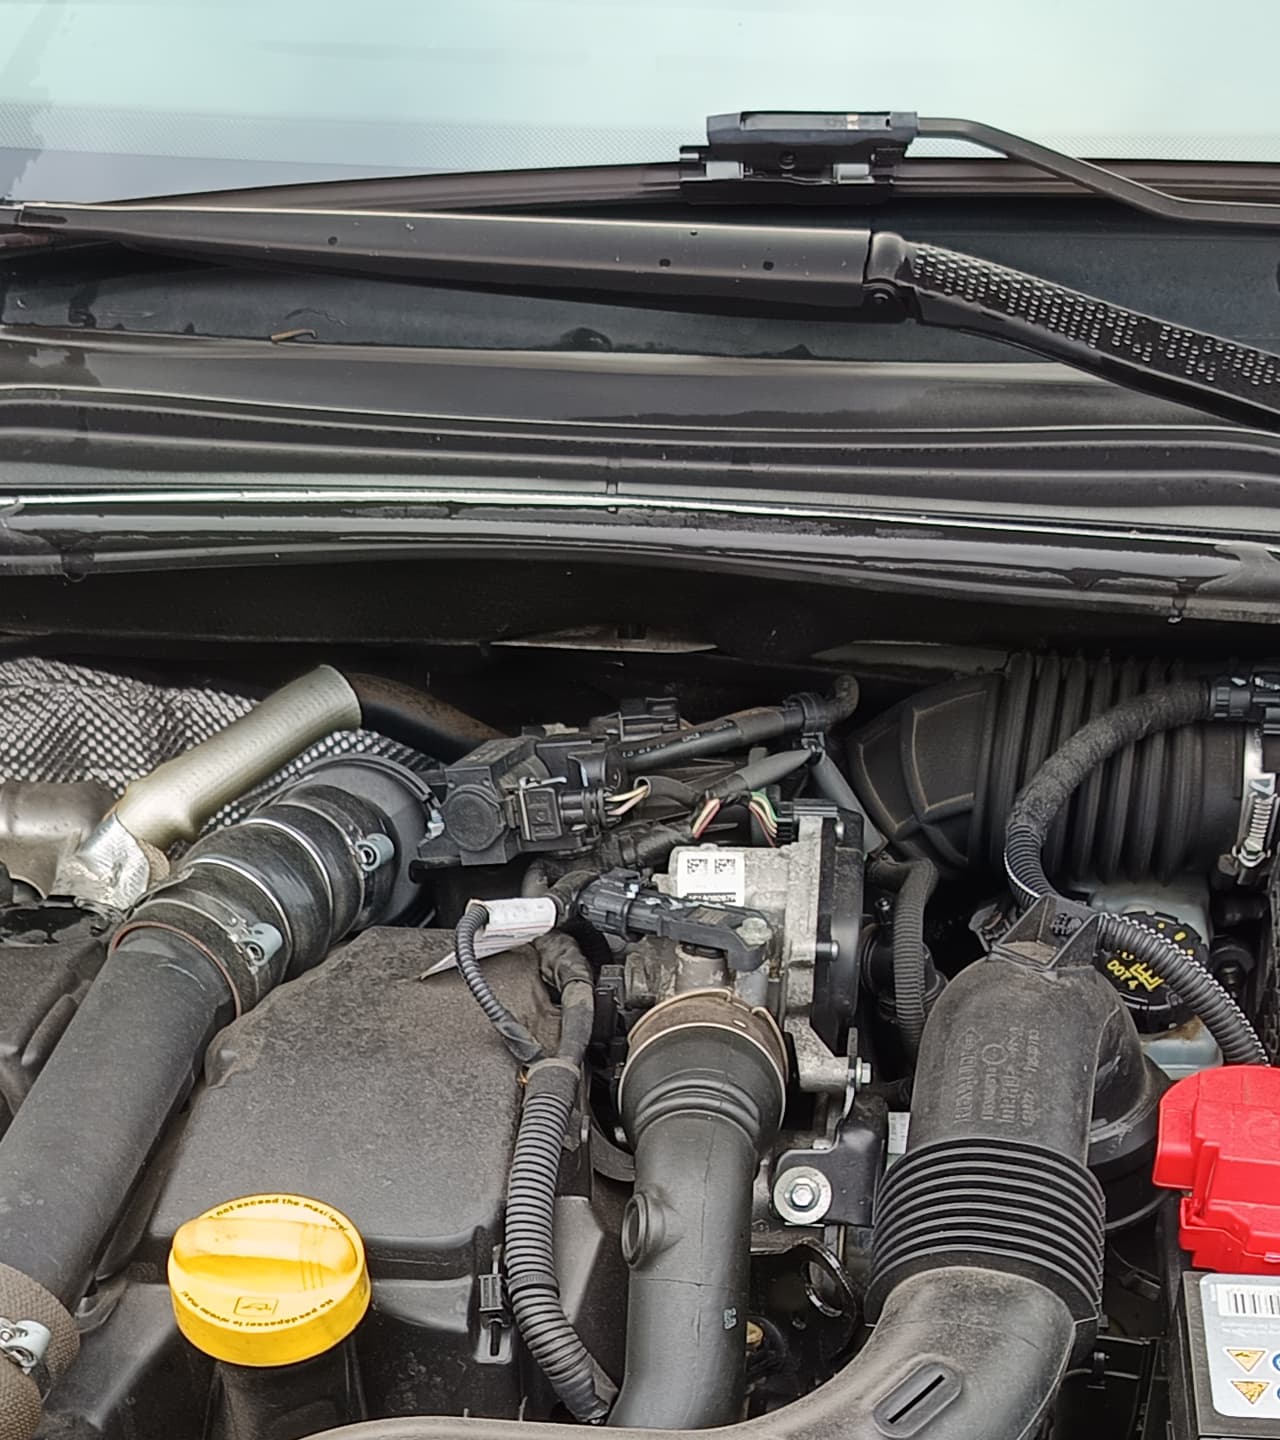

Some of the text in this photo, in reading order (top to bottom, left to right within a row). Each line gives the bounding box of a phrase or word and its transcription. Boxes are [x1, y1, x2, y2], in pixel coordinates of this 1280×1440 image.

[1107, 959, 1132, 980] DOT
[237, 1197, 280, 1209] exceed
[282, 1197, 300, 1207] the
